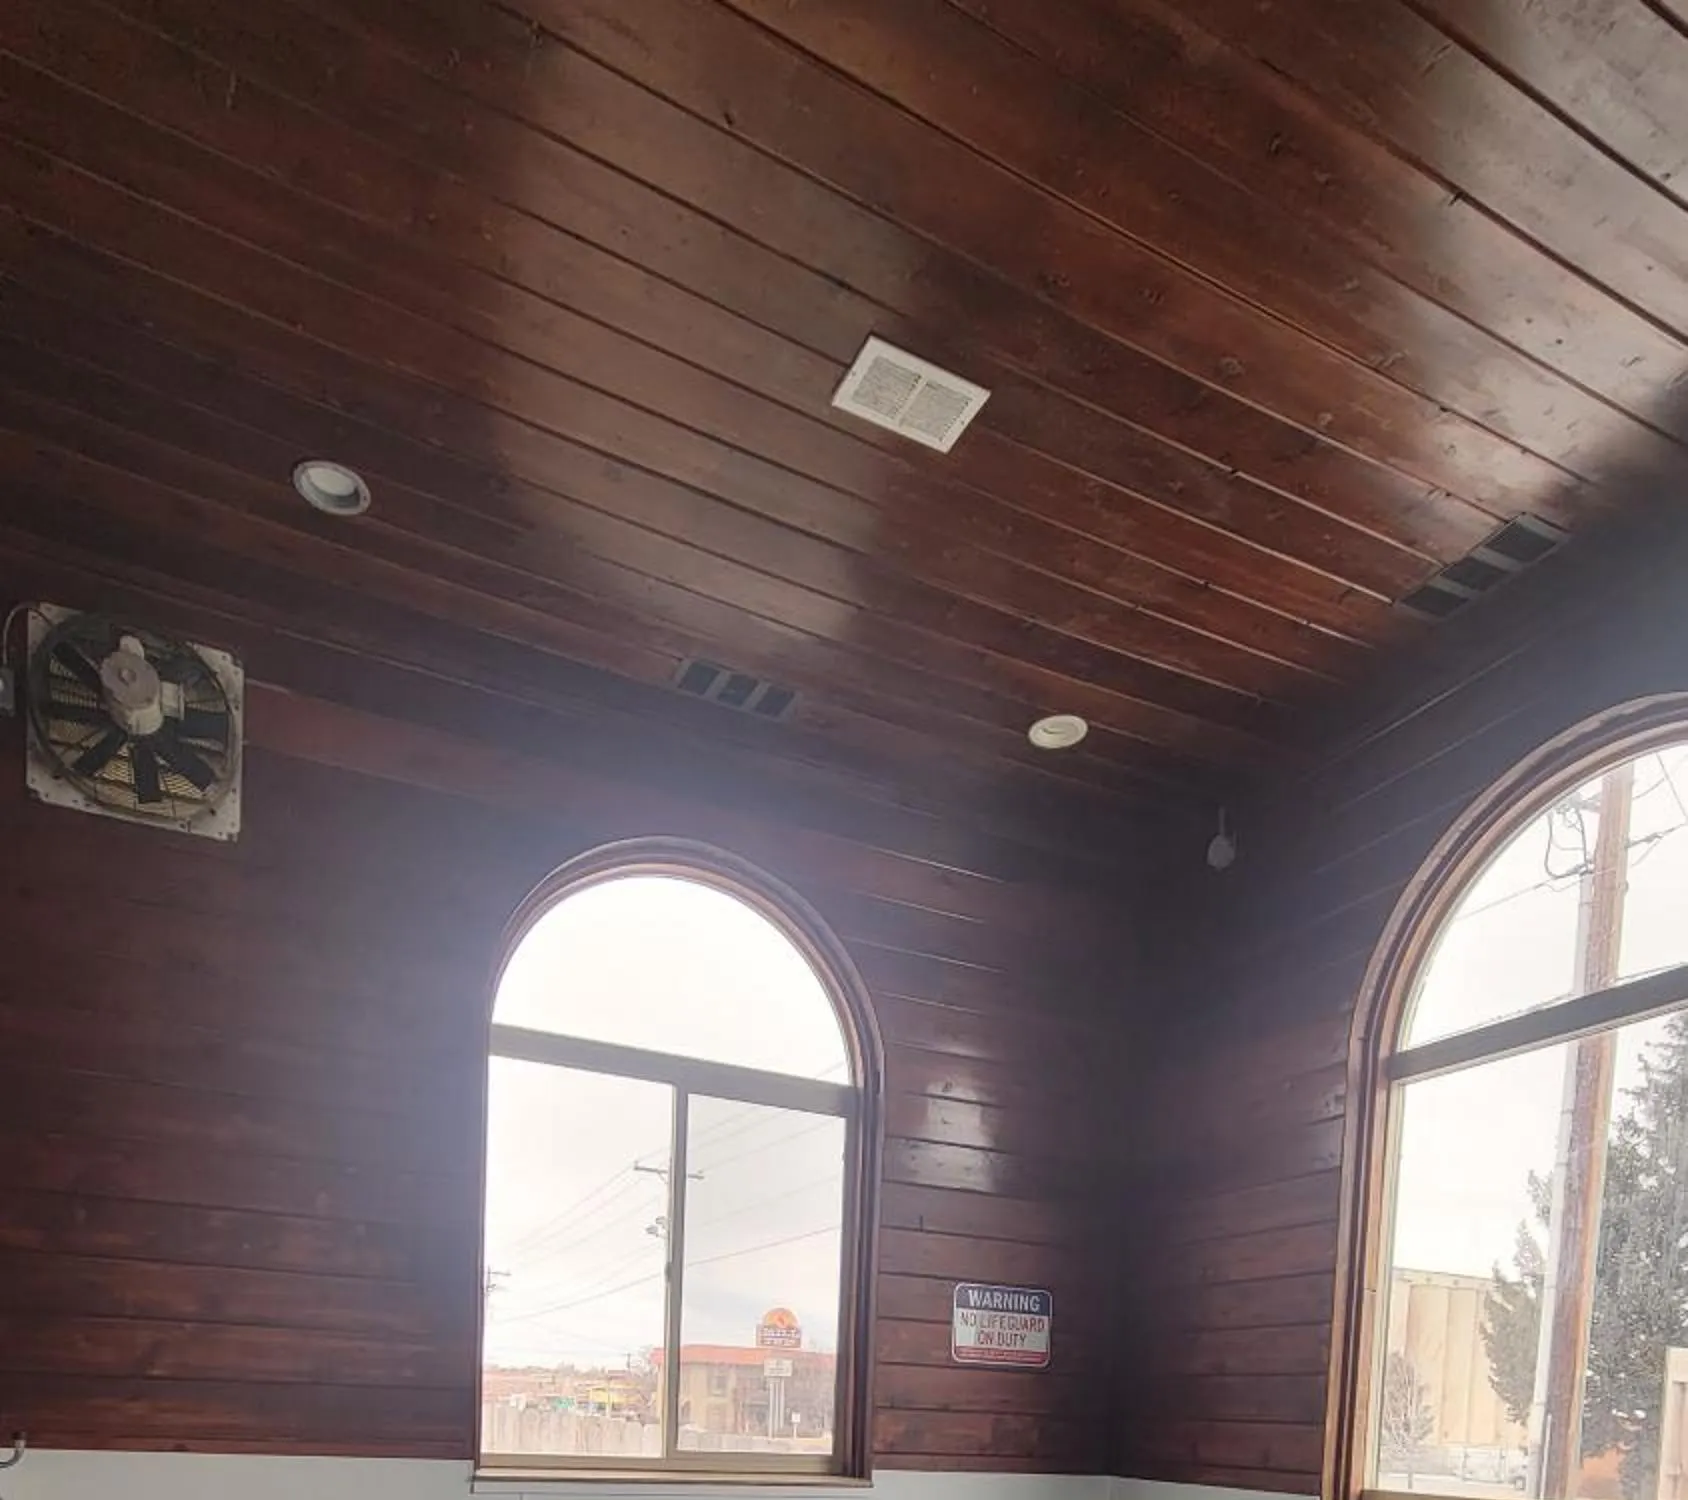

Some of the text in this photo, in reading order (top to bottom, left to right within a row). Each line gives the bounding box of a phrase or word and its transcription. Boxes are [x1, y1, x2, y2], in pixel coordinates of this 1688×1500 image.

[968, 1290, 1041, 1312] WARNING
[960, 1311, 977, 1327] NO
[977, 1330, 1027, 1348] ON DUTY
